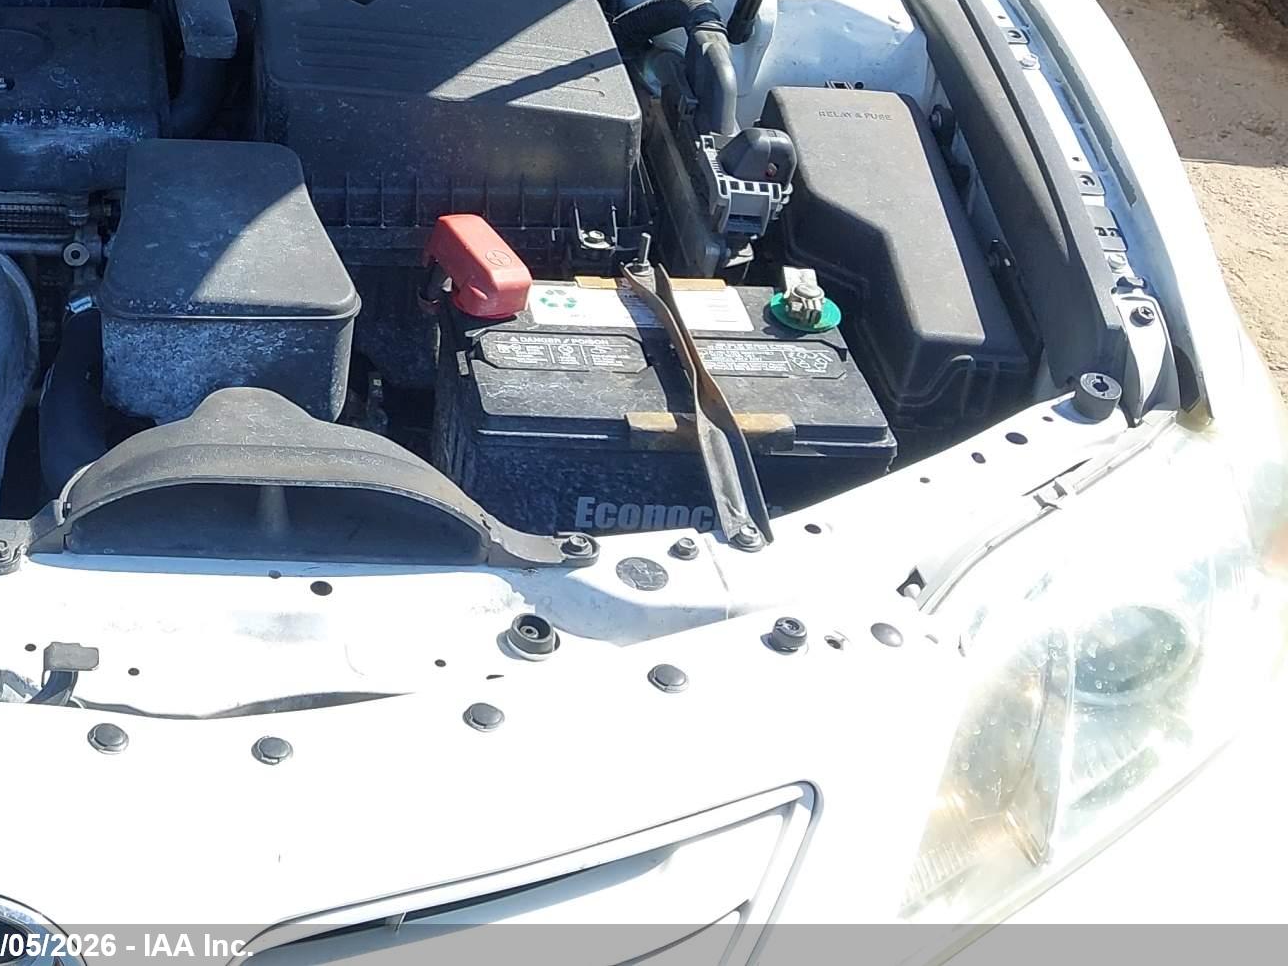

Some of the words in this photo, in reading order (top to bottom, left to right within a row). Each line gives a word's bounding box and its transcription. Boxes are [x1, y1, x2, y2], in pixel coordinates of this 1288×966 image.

[818, 110, 852, 118] RELAY
[864, 112, 893, 121] FUSE
[519, 336, 562, 344] DANGER
[570, 337, 609, 345] POISON
[575, 496, 782, 532] Econoc
